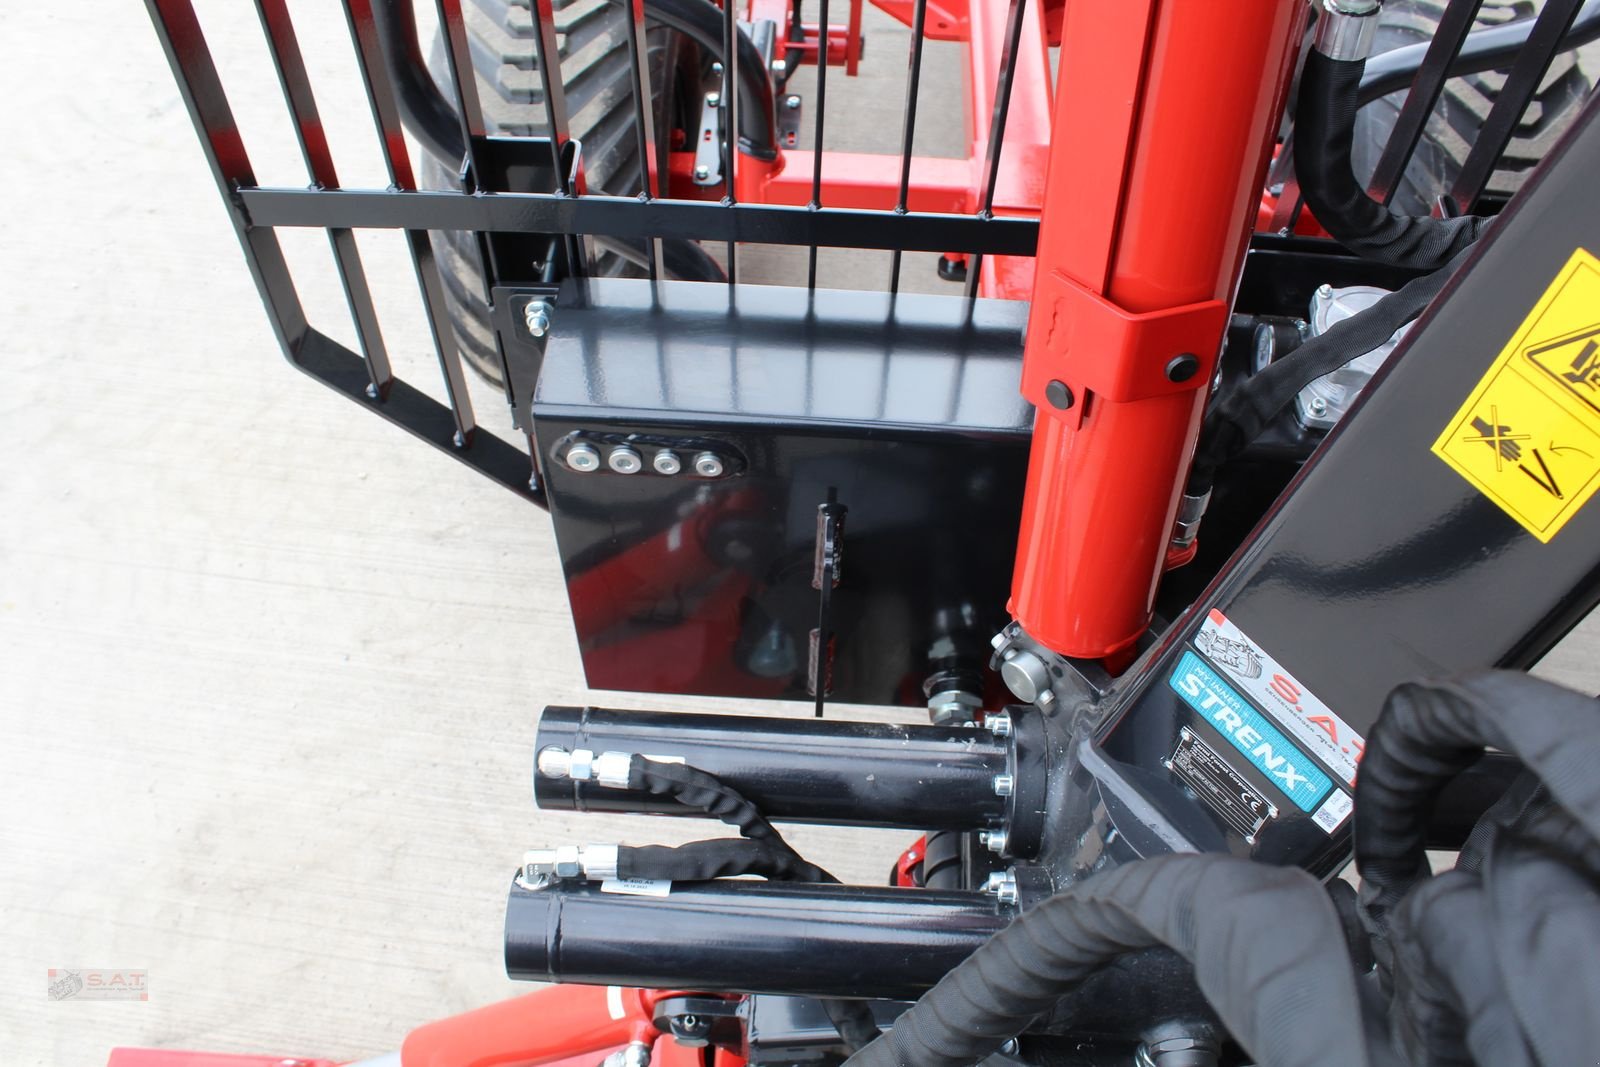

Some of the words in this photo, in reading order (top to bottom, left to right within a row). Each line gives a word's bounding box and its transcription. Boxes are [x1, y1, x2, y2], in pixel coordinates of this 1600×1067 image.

[1195, 667, 1211, 681] MY
[1210, 681, 1241, 709] INNER
[1229, 772, 1263, 804] Corporation
